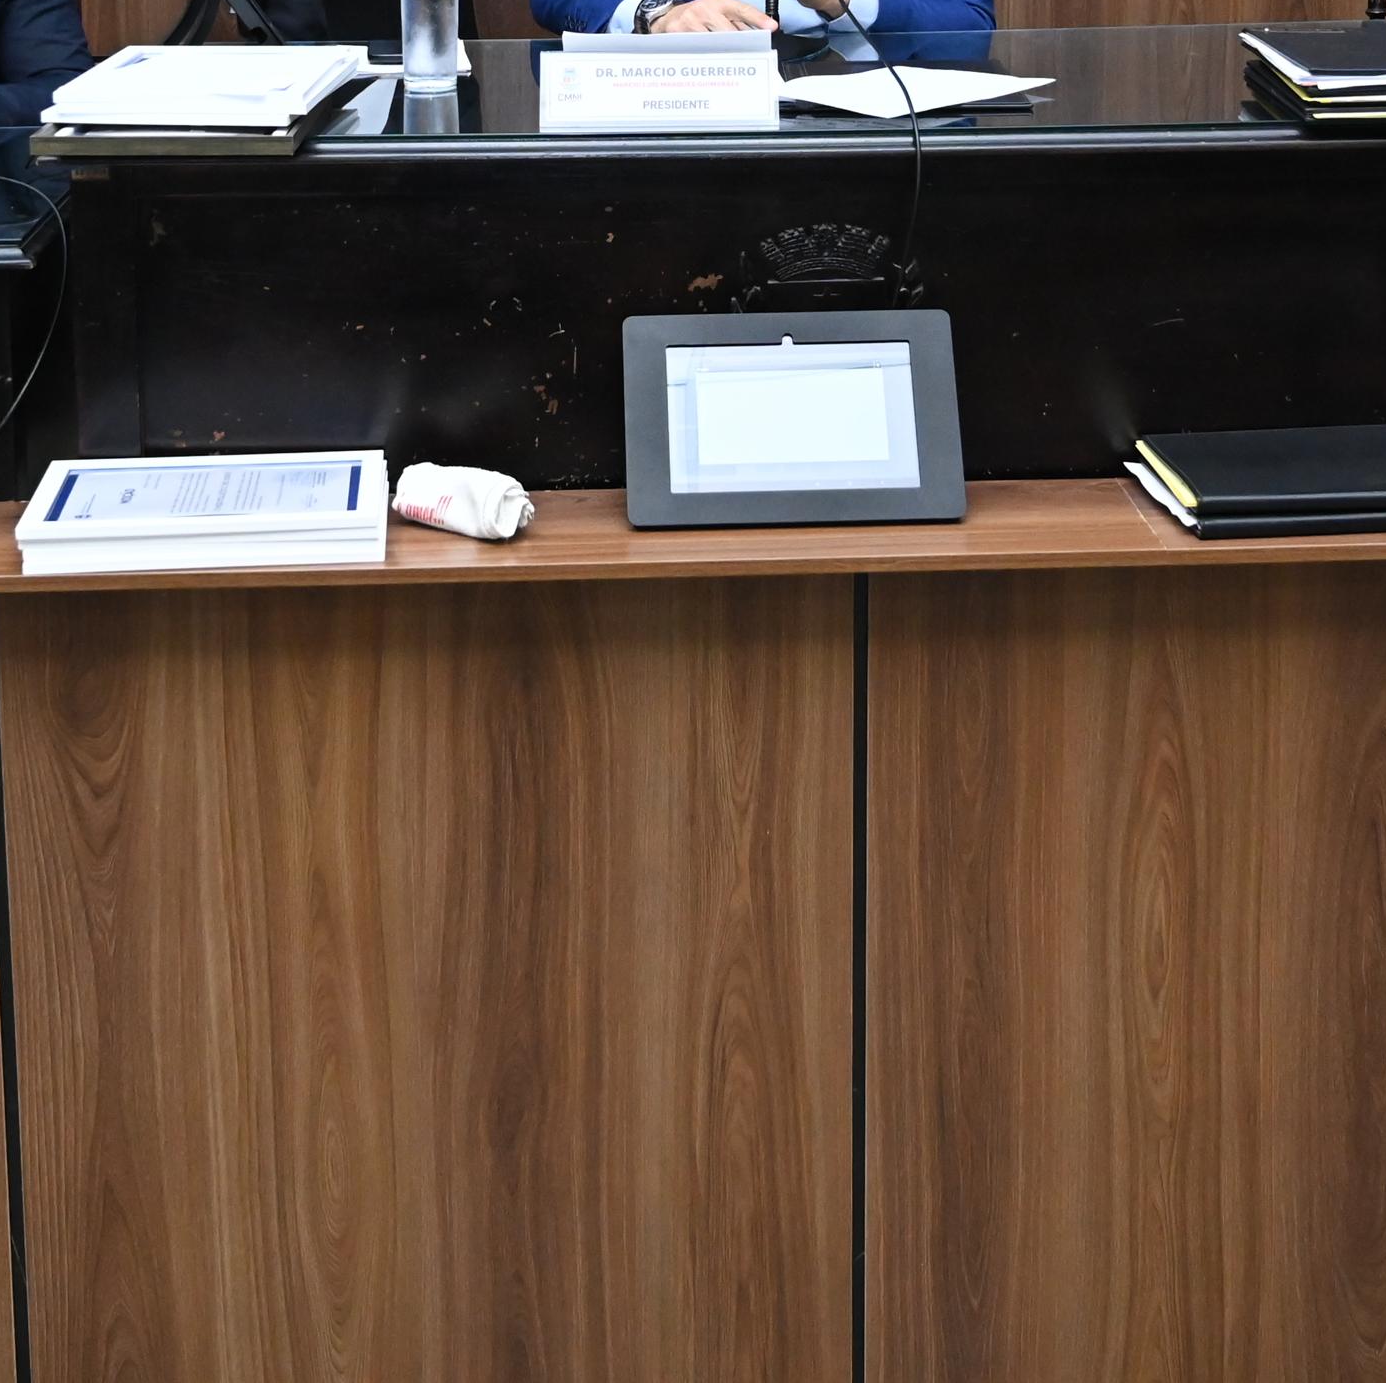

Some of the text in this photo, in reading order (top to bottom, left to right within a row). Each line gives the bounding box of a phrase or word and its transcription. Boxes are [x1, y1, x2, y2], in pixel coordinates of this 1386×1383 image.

[595, 66, 757, 78] DR. MARCIO GUERREIRO
[642, 99, 710, 110] PRESIDENTE
